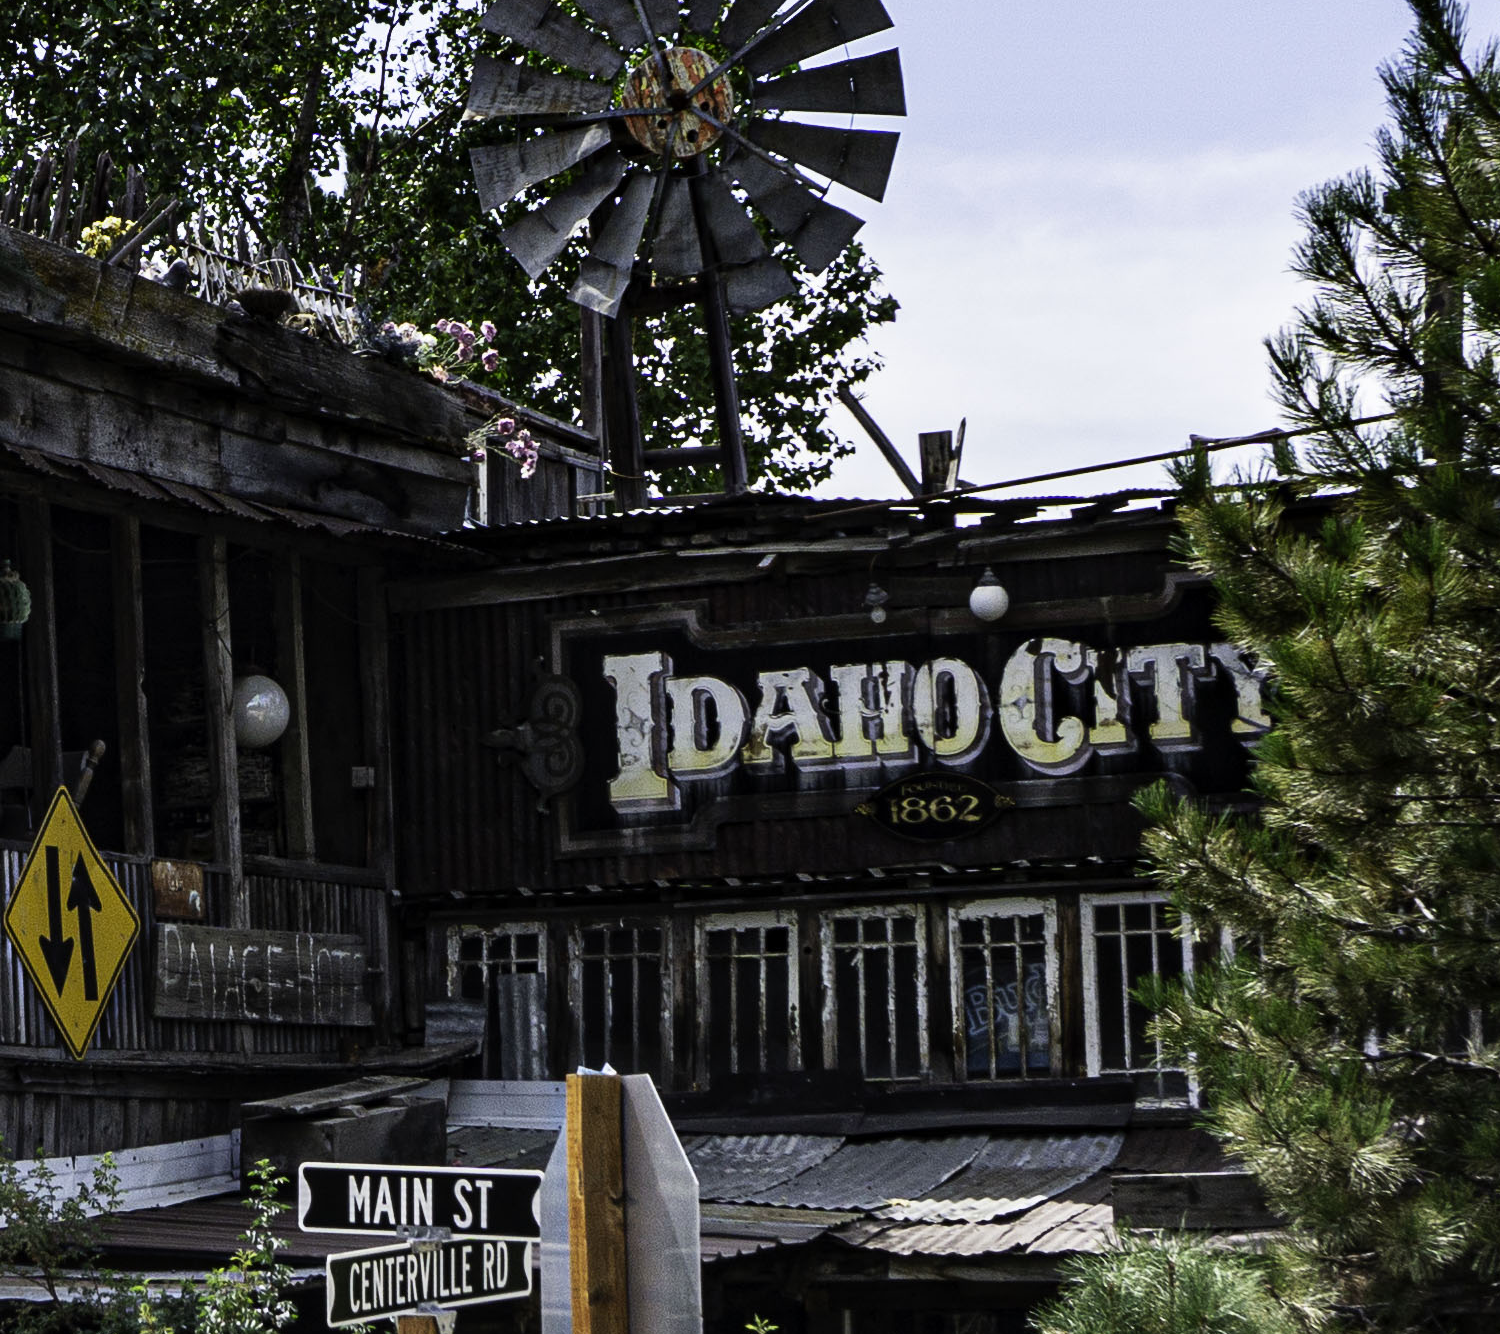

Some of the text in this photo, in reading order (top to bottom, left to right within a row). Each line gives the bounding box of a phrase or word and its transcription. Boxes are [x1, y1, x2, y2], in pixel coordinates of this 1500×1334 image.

[603, 651, 988, 809] IDAHO
[890, 795, 982, 824] 1862
[349, 1175, 493, 1230] MAIN ST
[349, 1241, 509, 1314] CENTERVILLE RD
